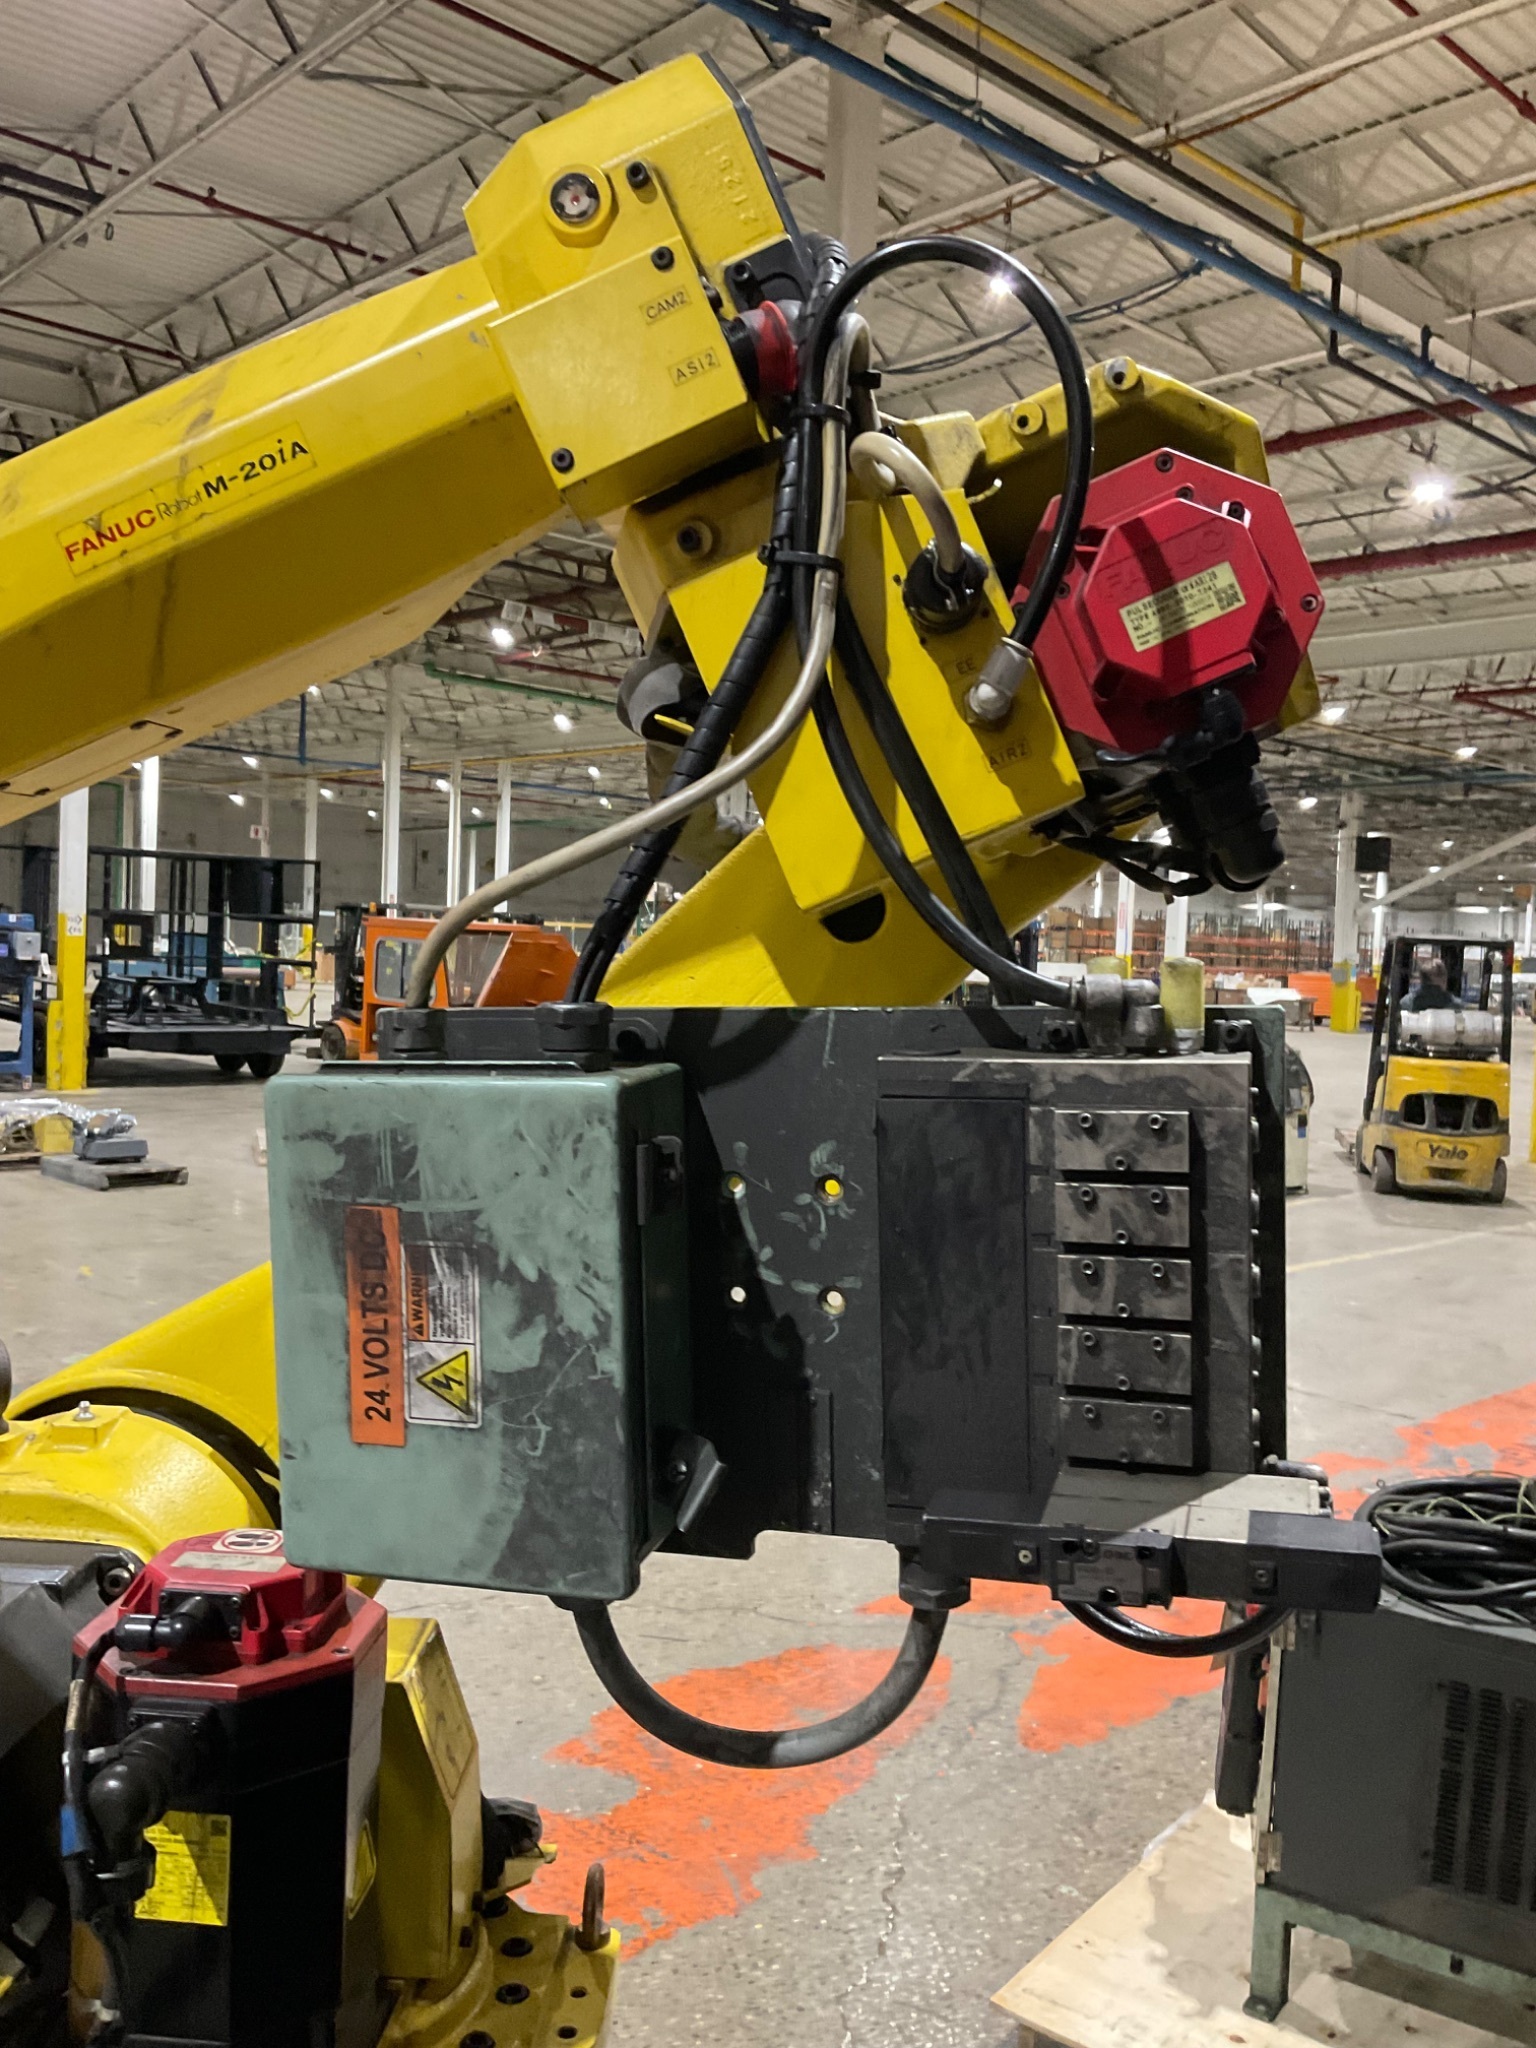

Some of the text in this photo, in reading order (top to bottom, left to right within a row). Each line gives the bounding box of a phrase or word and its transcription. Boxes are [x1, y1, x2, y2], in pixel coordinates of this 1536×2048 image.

[646, 291, 687, 319] CAM2
[64, 438, 309, 562] FANUC Robot M-20iA
[1429, 1143, 1469, 1160] Yale
[411, 1264, 424, 1321] WARNI
[359, 1229, 391, 1423] 24 VOLTS DC
